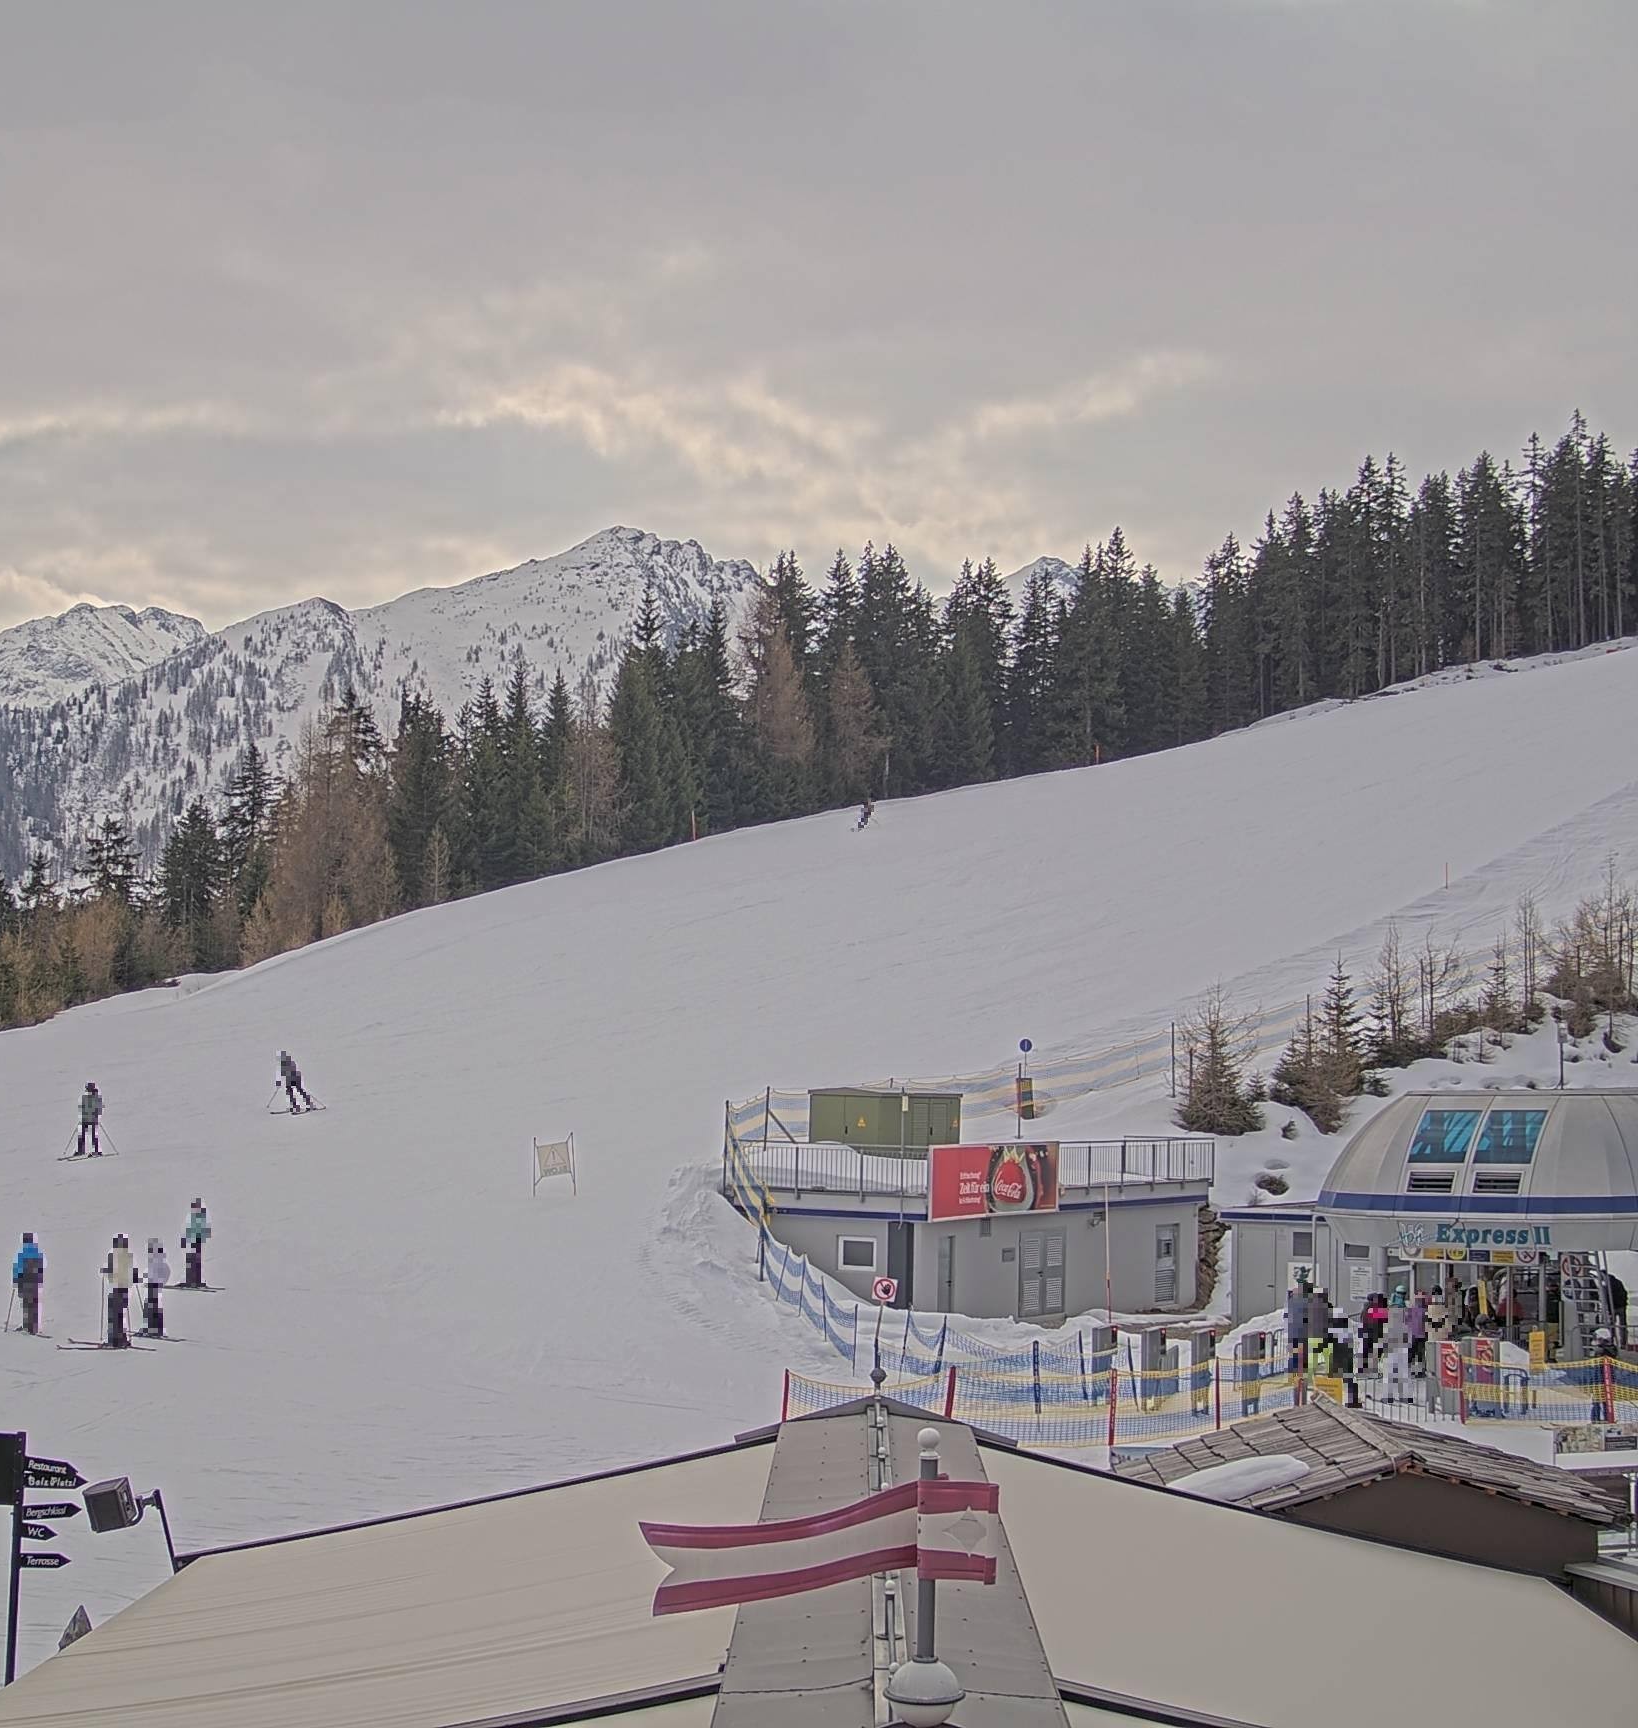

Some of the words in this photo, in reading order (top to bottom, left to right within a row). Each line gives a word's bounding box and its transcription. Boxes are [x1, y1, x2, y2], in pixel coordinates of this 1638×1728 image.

[1436, 1223, 1529, 1248] Express
[1533, 1226, 1551, 1245] II
[28, 1460, 67, 1474] Restaurant
[28, 1526, 45, 1538] WC
[26, 1555, 60, 1566] Terrasse
